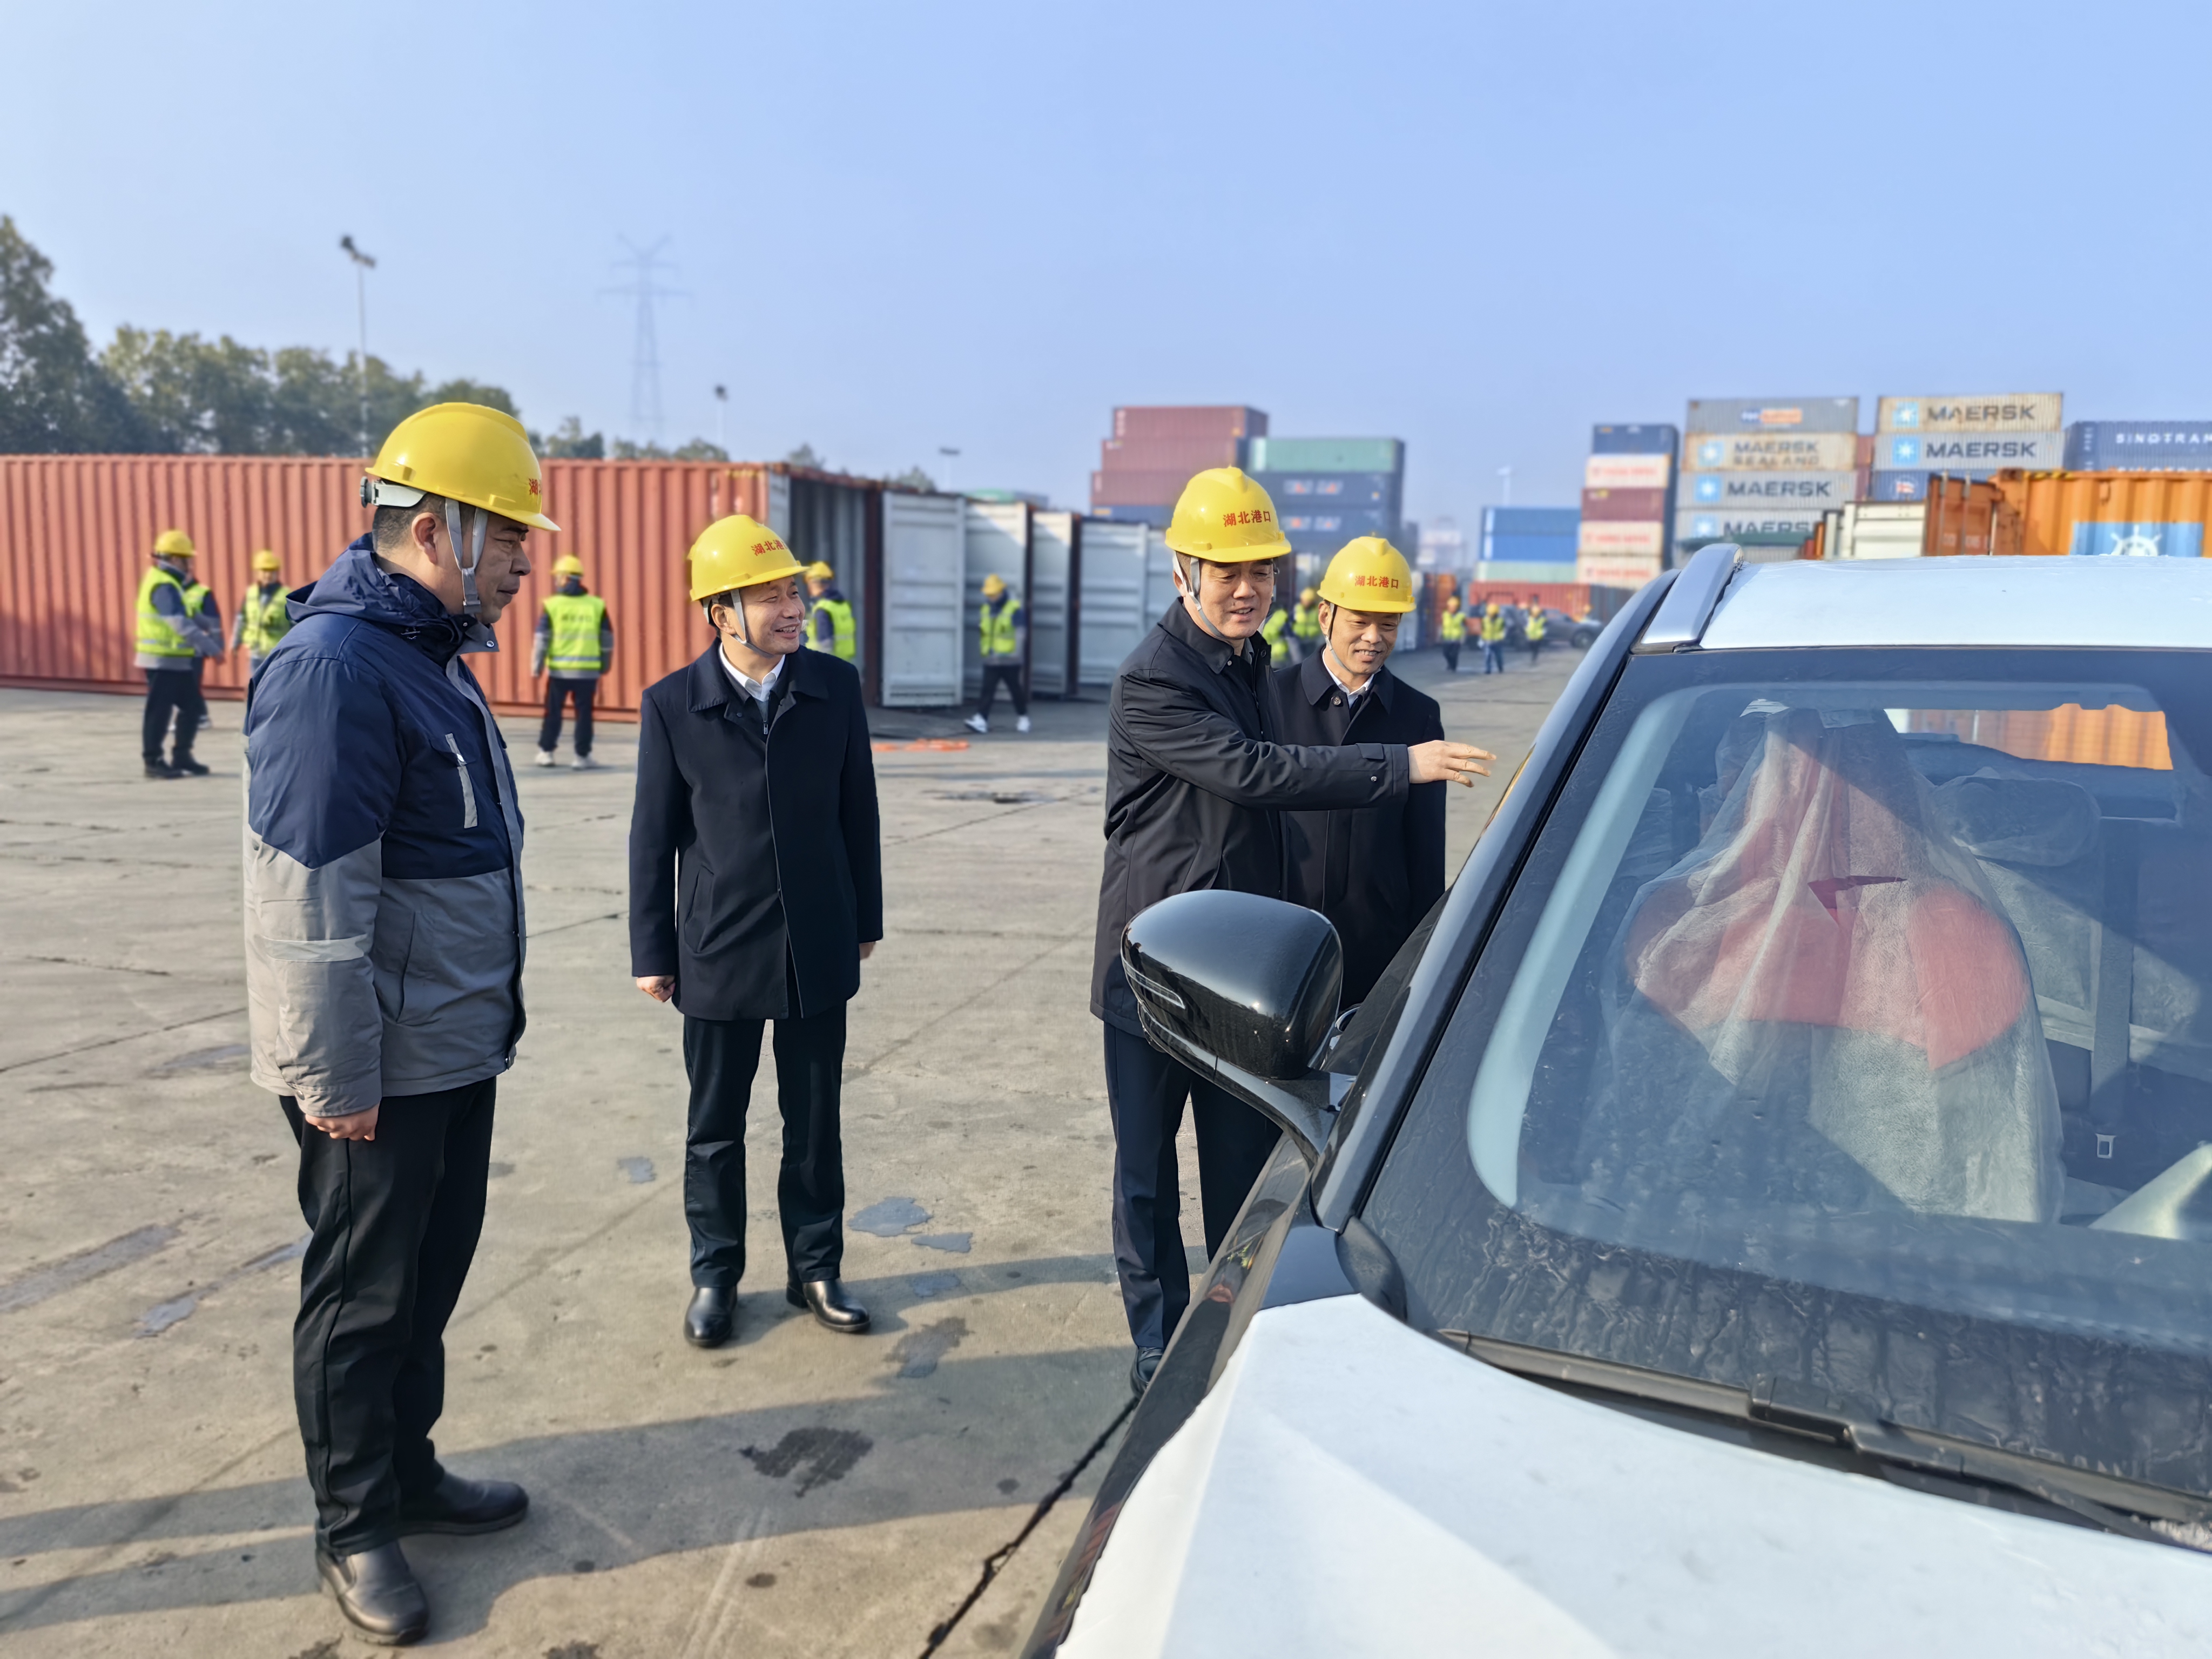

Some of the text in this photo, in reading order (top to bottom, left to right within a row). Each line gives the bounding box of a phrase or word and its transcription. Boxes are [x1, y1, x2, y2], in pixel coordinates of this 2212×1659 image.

[1927, 404, 2036, 420] MAERSK
[1735, 442, 1817, 453] MAERSK
[1926, 442, 2036, 458] MAERSK
[1728, 482, 1830, 496] MAERSK
[1223, 509, 1271, 528] 湖北港口
[1724, 522, 1809, 534] MAERS
[1354, 575, 1399, 589] 湖北港口
